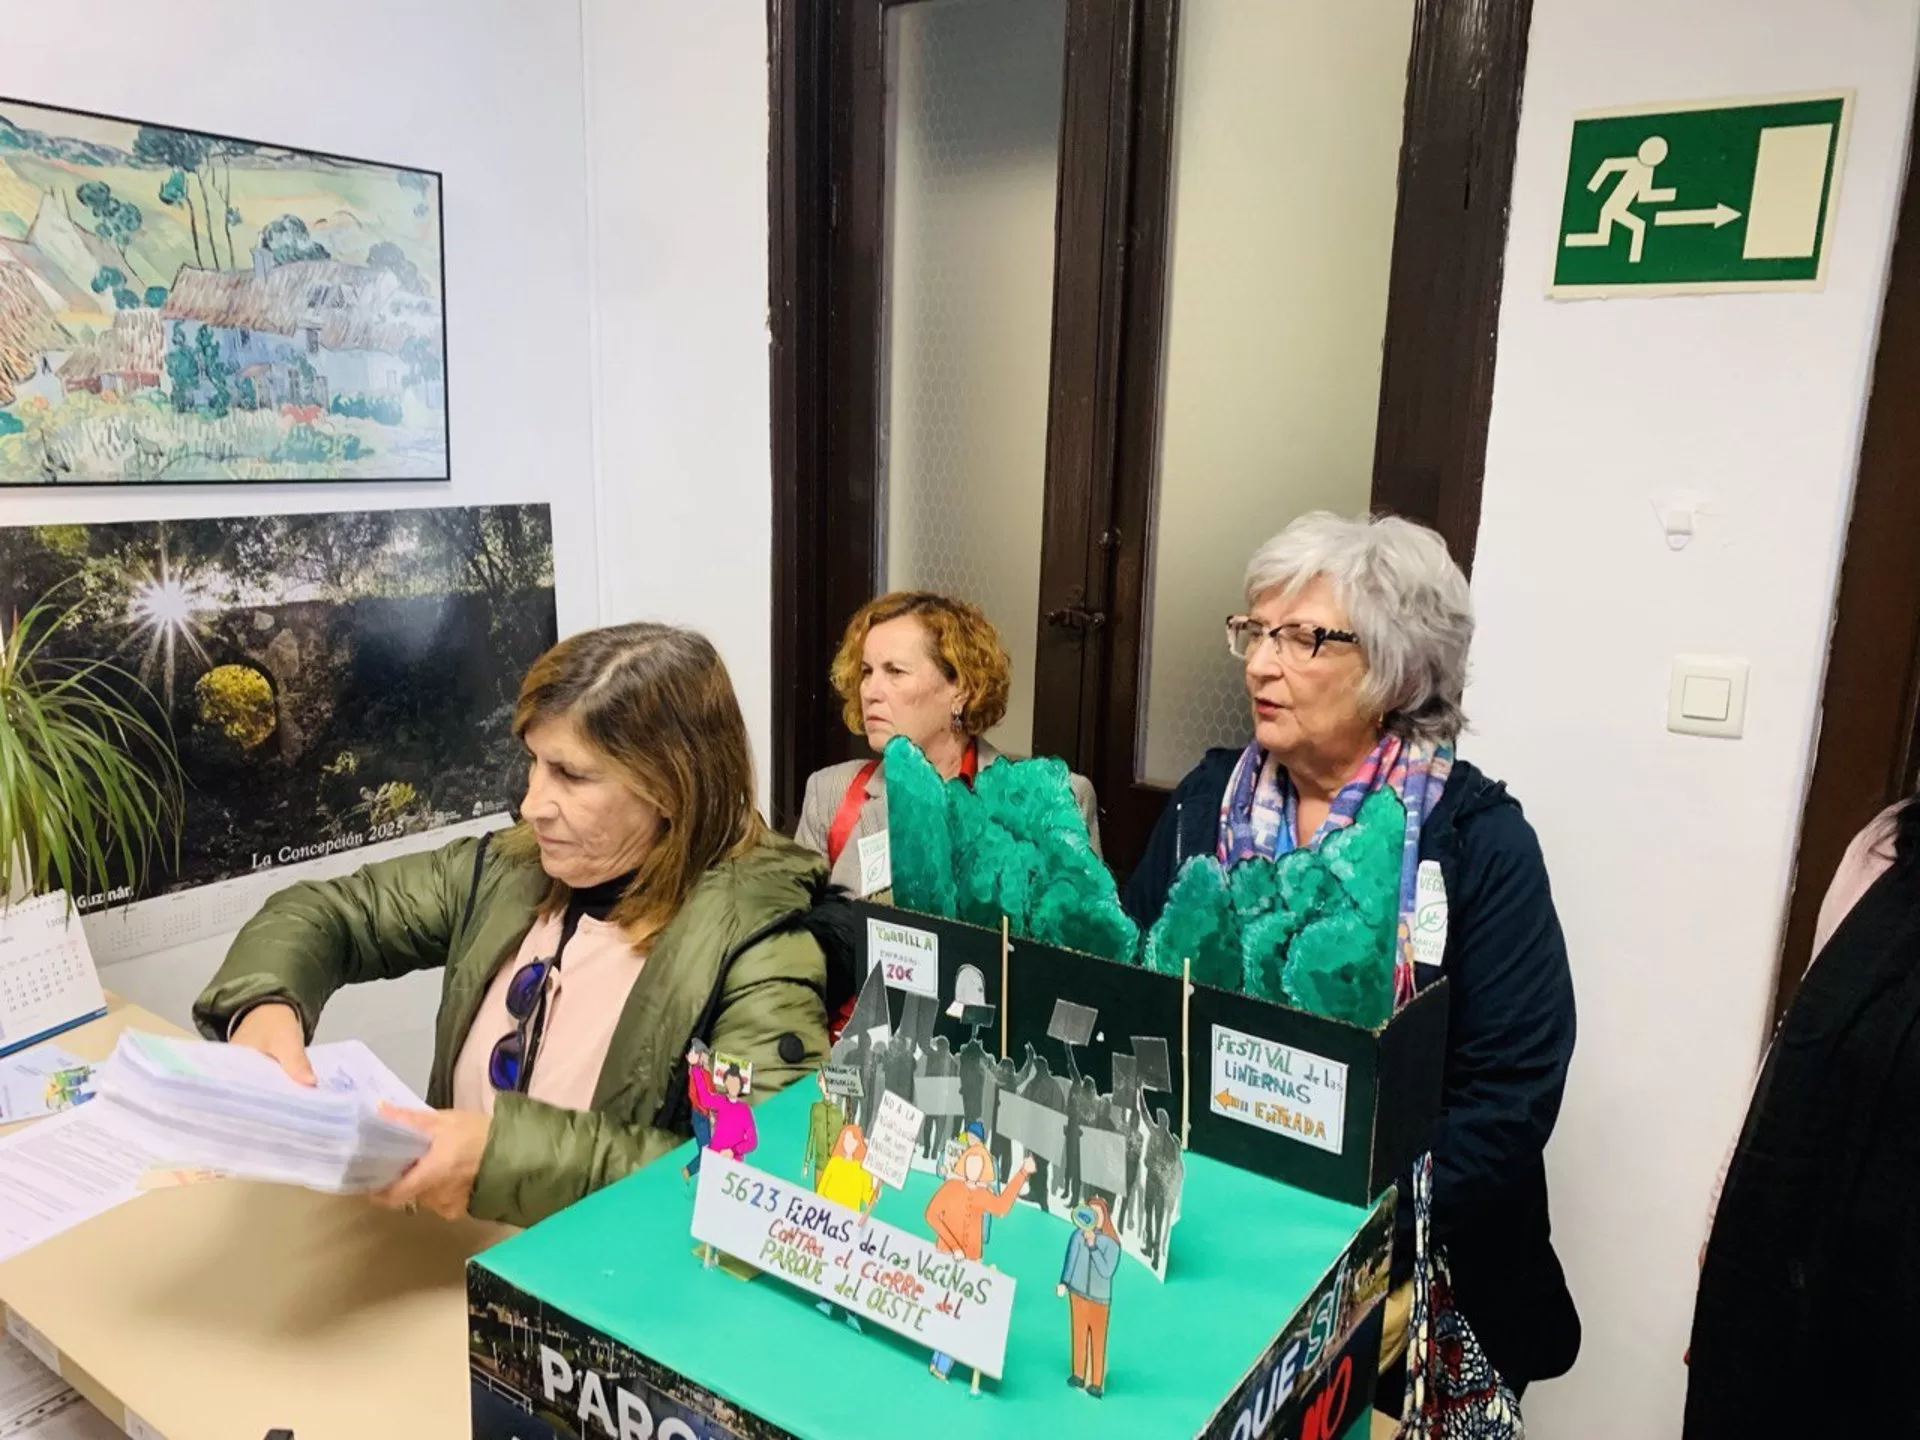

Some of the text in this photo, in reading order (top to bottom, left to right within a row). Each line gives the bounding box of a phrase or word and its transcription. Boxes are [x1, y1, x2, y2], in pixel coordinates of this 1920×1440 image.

[252, 821, 404, 869] La Concepción 2025
[886, 963, 914, 982] 20€
[1216, 1033, 1293, 1076] FESTIVAL
[759, 1239, 829, 1285] PARQUE
[866, 1286, 932, 1332] OESTE
